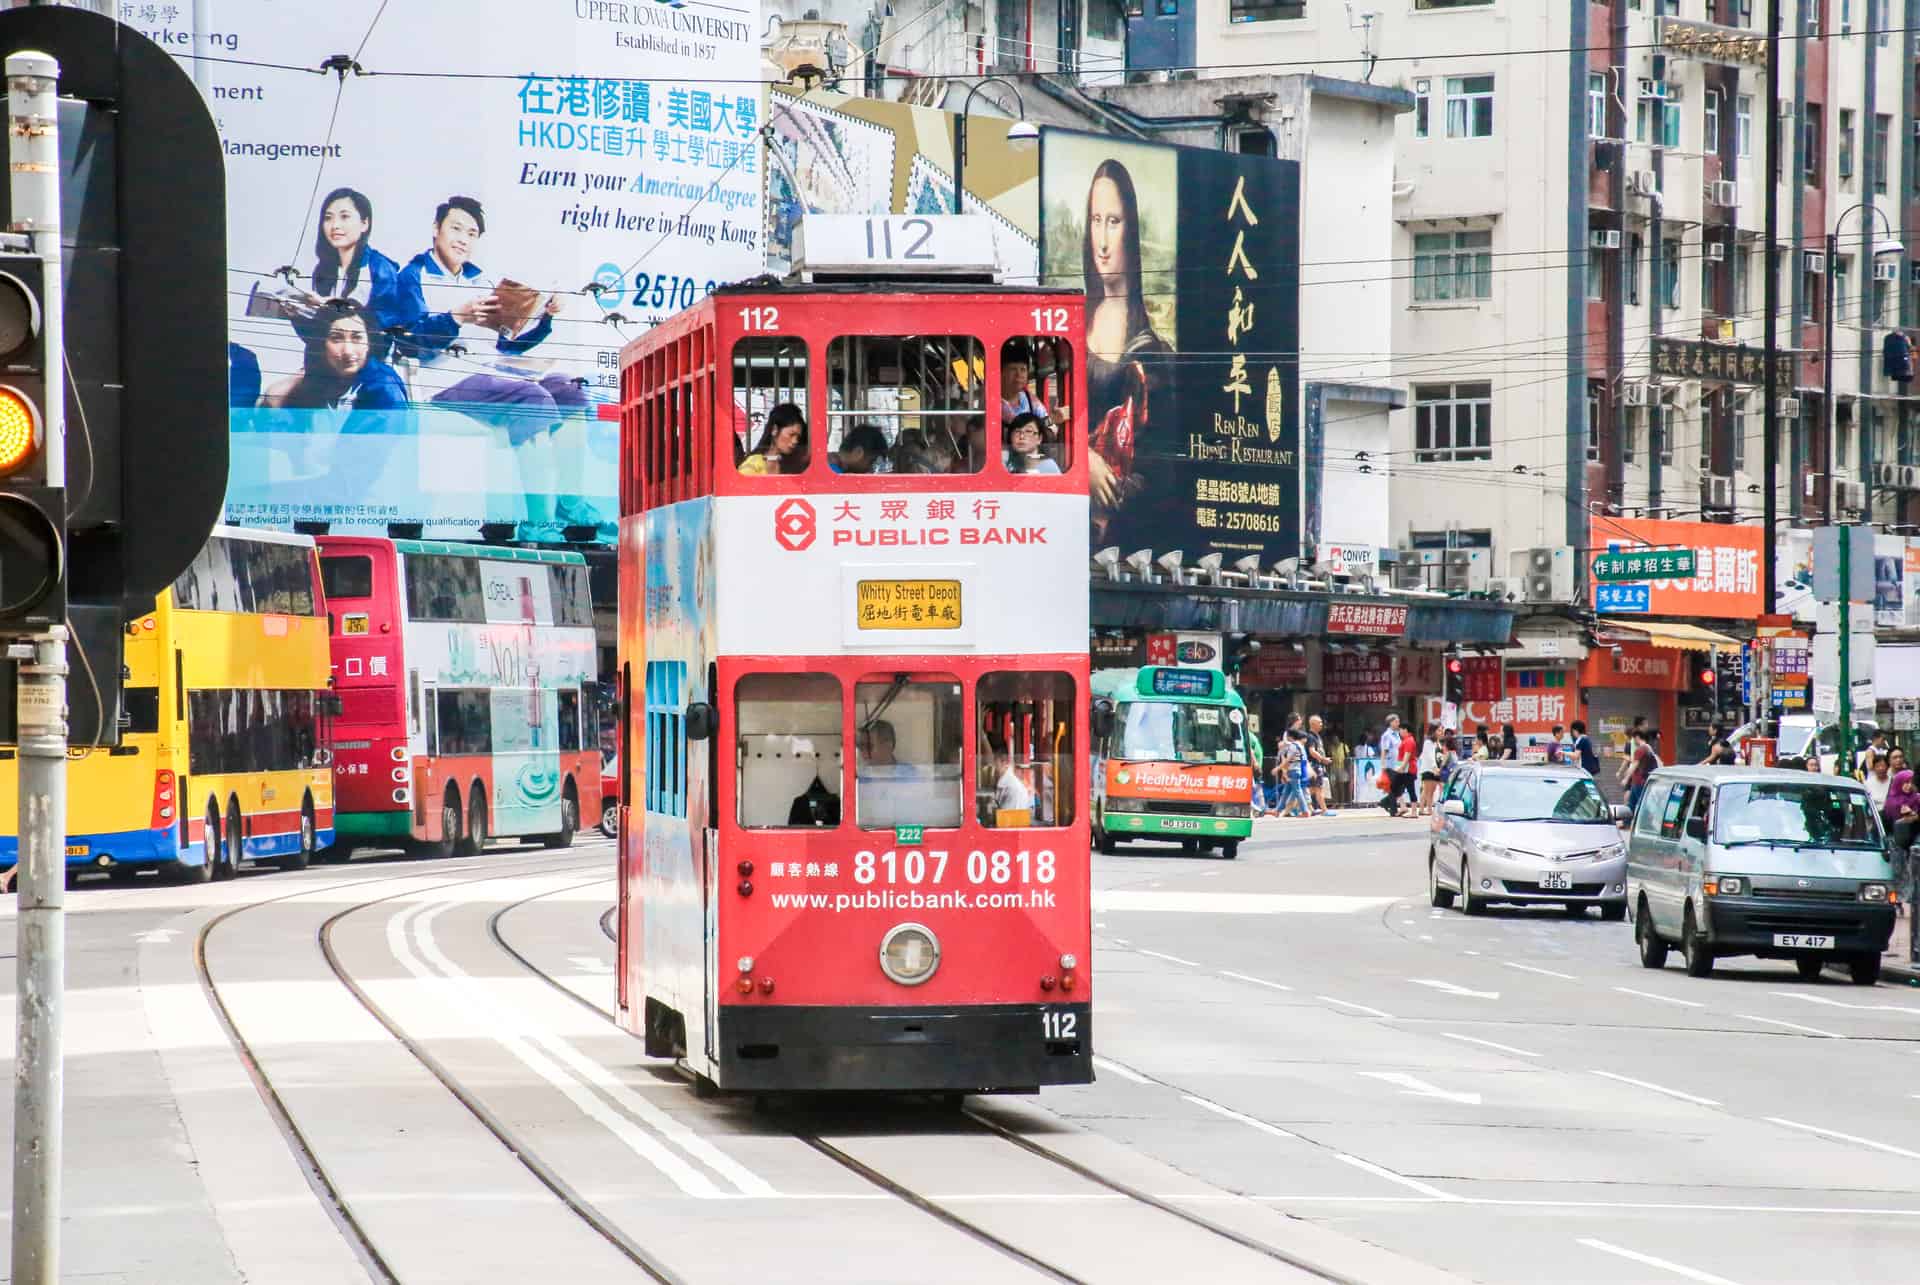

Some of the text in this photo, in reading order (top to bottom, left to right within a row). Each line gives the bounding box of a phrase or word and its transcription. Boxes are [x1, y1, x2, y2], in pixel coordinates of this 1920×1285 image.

[575, 0, 752, 43] UPPER IOWA UNIVERSITY
[616, 31, 717, 61] Established in 1857
[519, 162, 757, 212] Earn your American Degree
[560, 203, 758, 250] right here in Hong Kong
[865, 218, 936, 260] 112
[632, 272, 695, 310] 2510
[739, 306, 779, 331] 112
[1030, 308, 1070, 332] 112
[425, 516, 481, 527] qualification
[833, 526, 1049, 547] PUBLIC BANK
[1342, 549, 1371, 563] CONVEY
[861, 584, 959, 603] Whitty Street Depot
[1135, 769, 1204, 787] HealthPlus
[898, 828, 922, 842] Z22
[853, 850, 1057, 885] 8107 0818
[1548, 871, 1562, 880] HK
[1543, 880, 1568, 889] 360
[771, 889, 1057, 913] www.publicbank.com.hk
[1782, 935, 1826, 947] EY 417
[1041, 1012, 1077, 1040] 112
